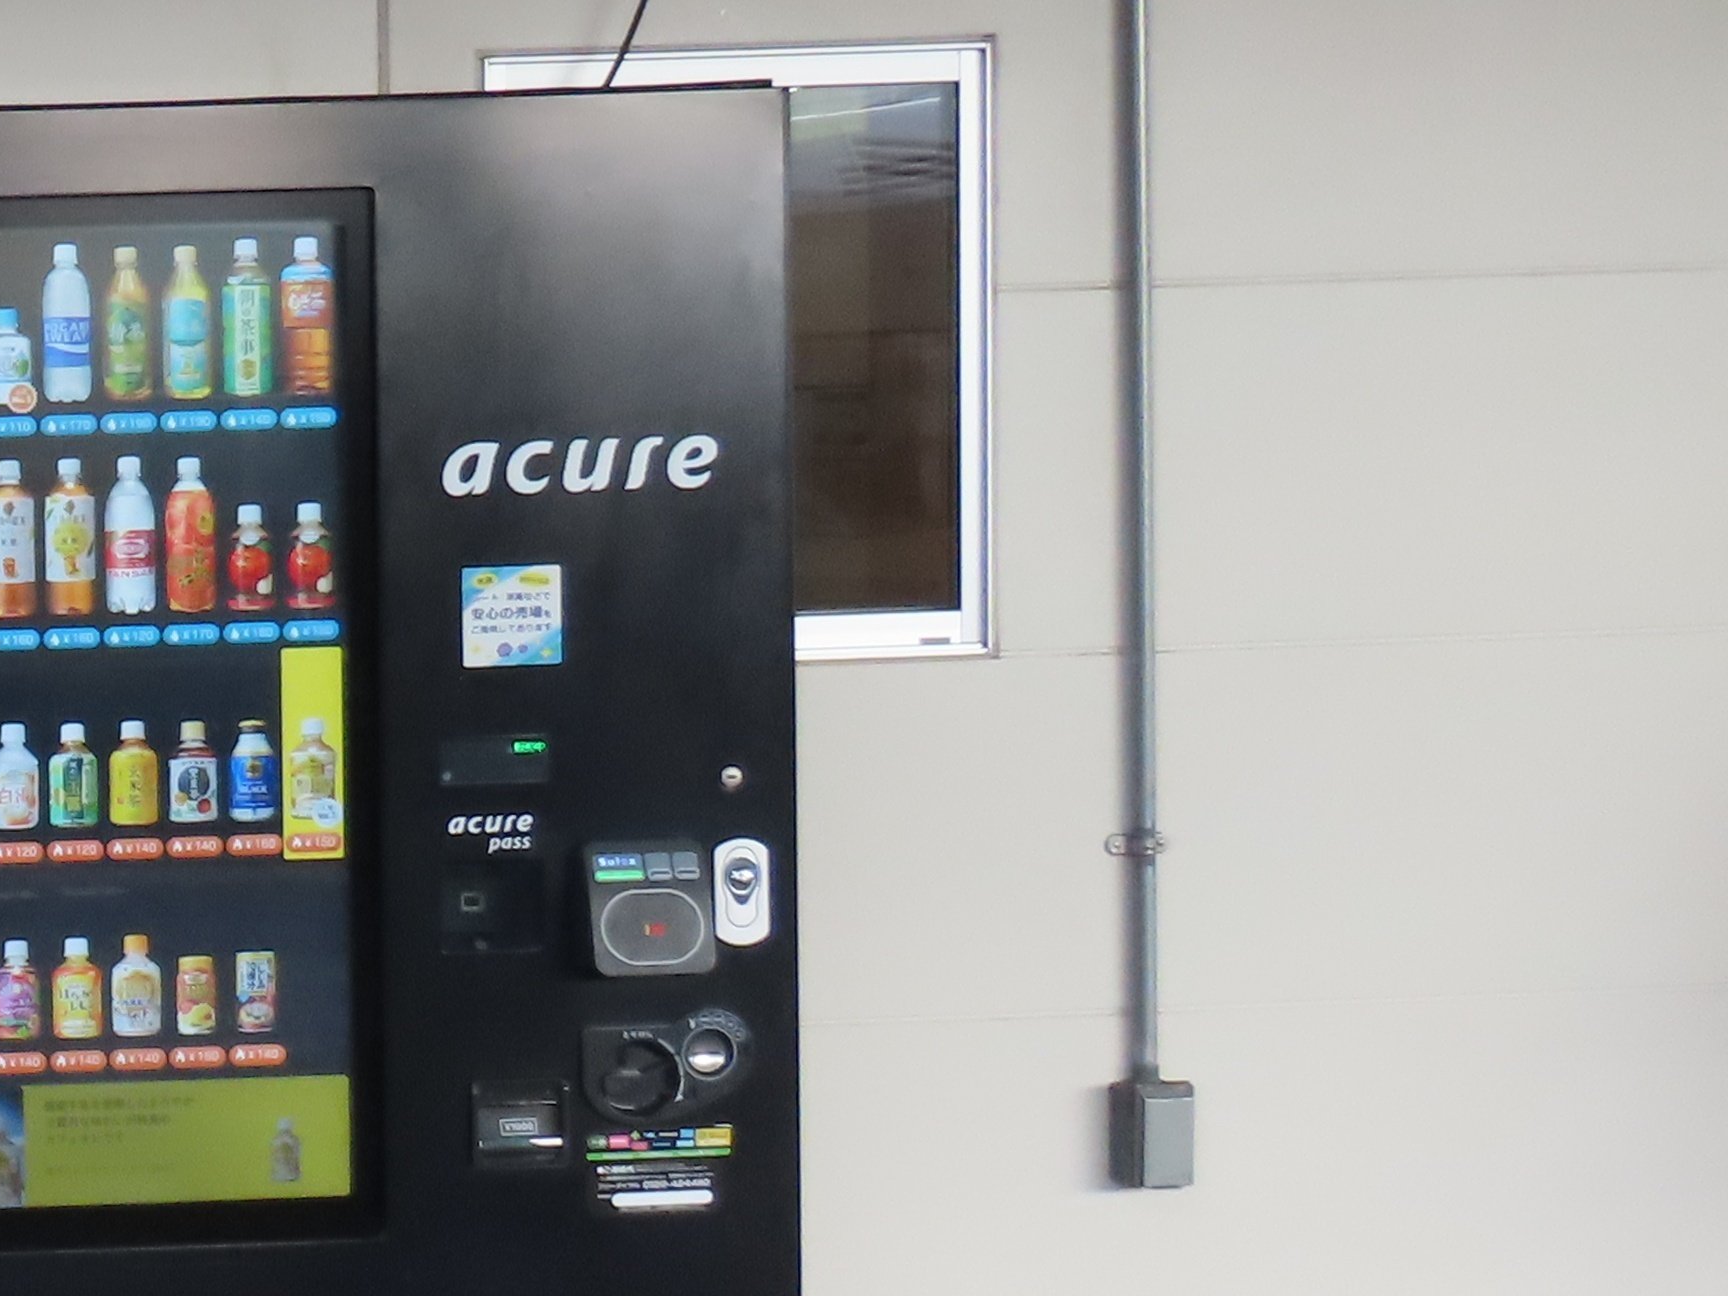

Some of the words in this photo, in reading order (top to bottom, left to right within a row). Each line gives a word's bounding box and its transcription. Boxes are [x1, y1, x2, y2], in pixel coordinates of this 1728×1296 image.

[441, 433, 720, 498] acure
[447, 811, 535, 836] acure
[487, 835, 533, 855] pass
